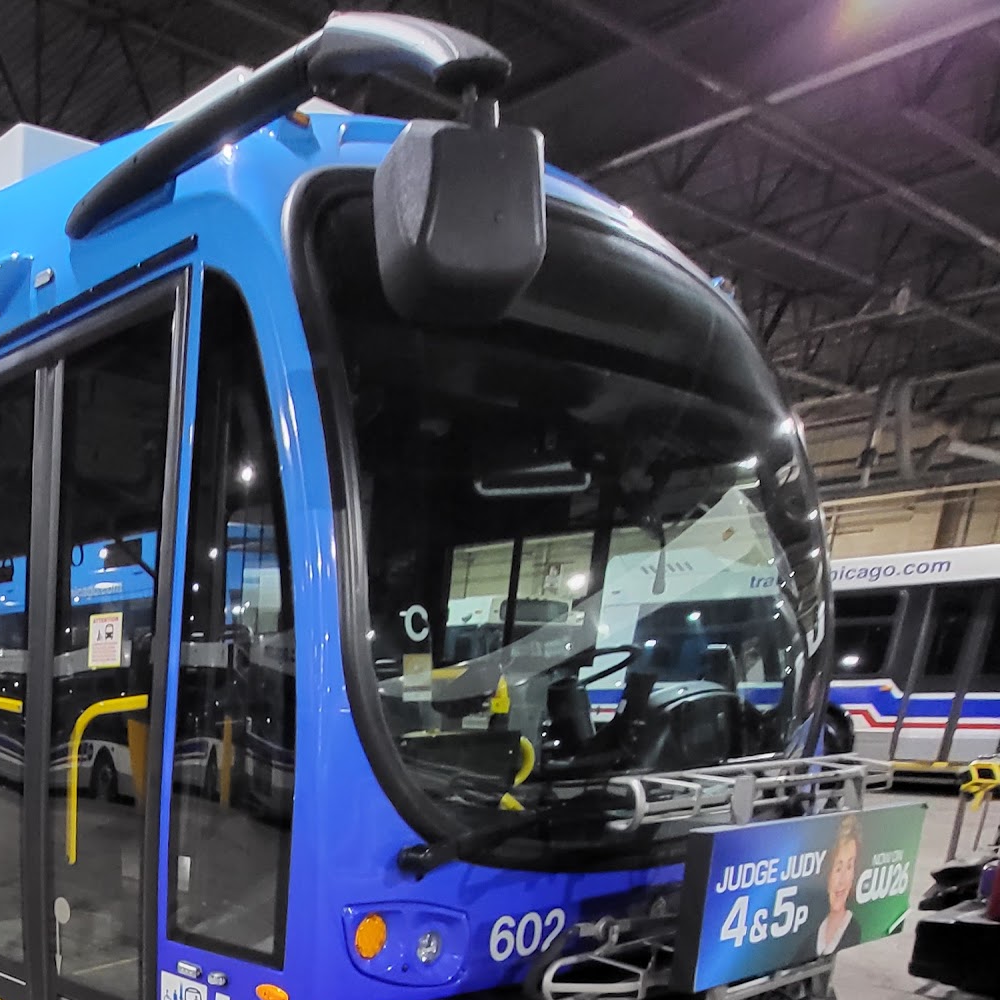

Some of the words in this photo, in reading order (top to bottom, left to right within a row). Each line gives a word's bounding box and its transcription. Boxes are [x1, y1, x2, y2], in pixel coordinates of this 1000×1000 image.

[716, 859, 780, 894] JUDGE
[780, 850, 827, 881] JUDY
[489, 907, 566, 962] 602
